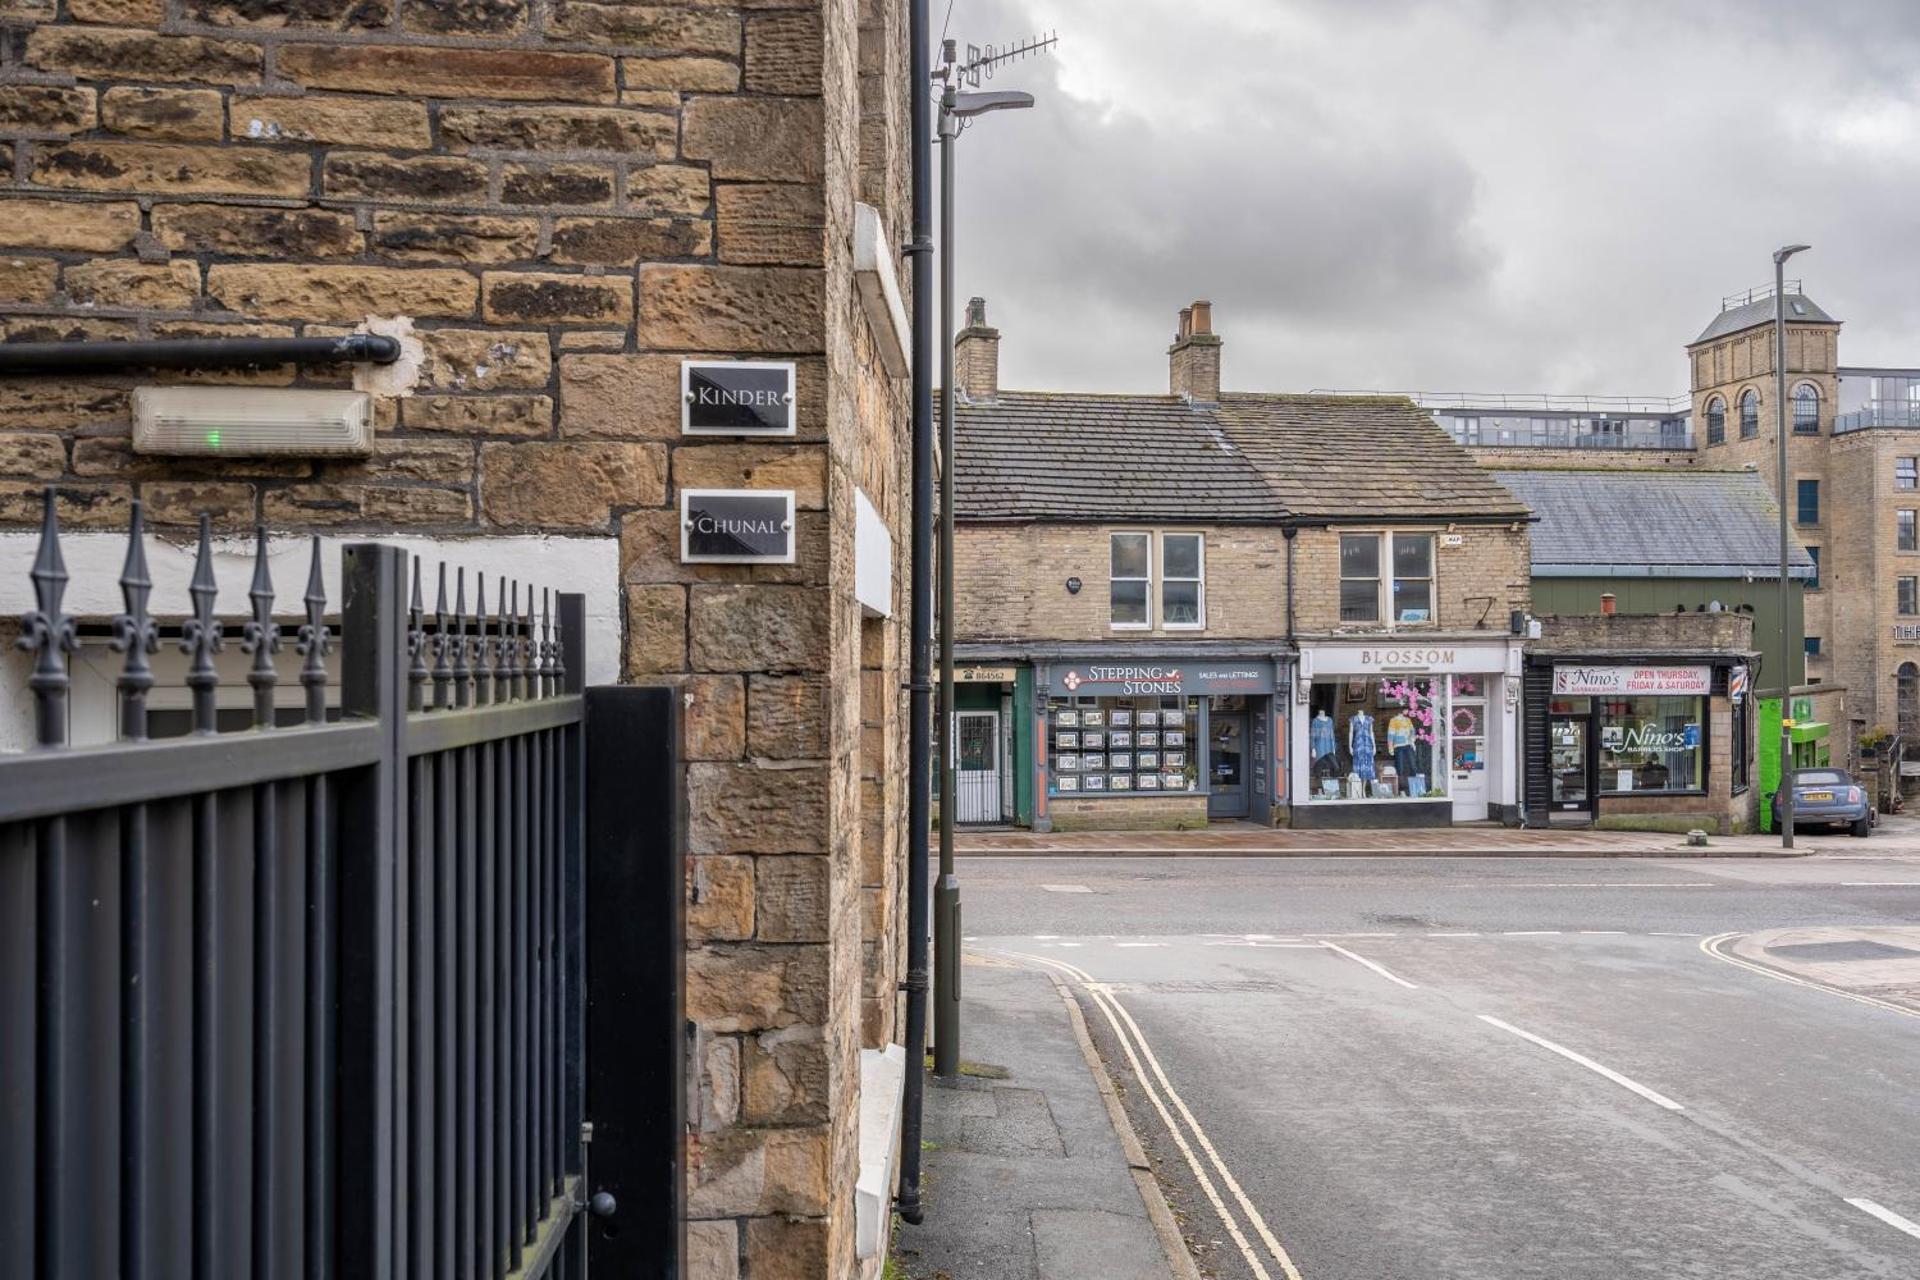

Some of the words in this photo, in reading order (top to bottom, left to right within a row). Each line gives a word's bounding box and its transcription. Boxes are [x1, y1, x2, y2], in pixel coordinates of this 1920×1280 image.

[1361, 650, 1455, 664] BLOSSOM
[1088, 666, 1163, 682] STEPPING
[1228, 671, 1260, 679] LETTINGS
[1571, 669, 1620, 686] Nino's
[1633, 670, 1655, 679] OPEN
[1123, 681, 1181, 695] STONES
[1626, 681, 1655, 690] FRIDAY
[1665, 681, 1706, 690] SATURDAY
[1611, 723, 1685, 753] Nino's
